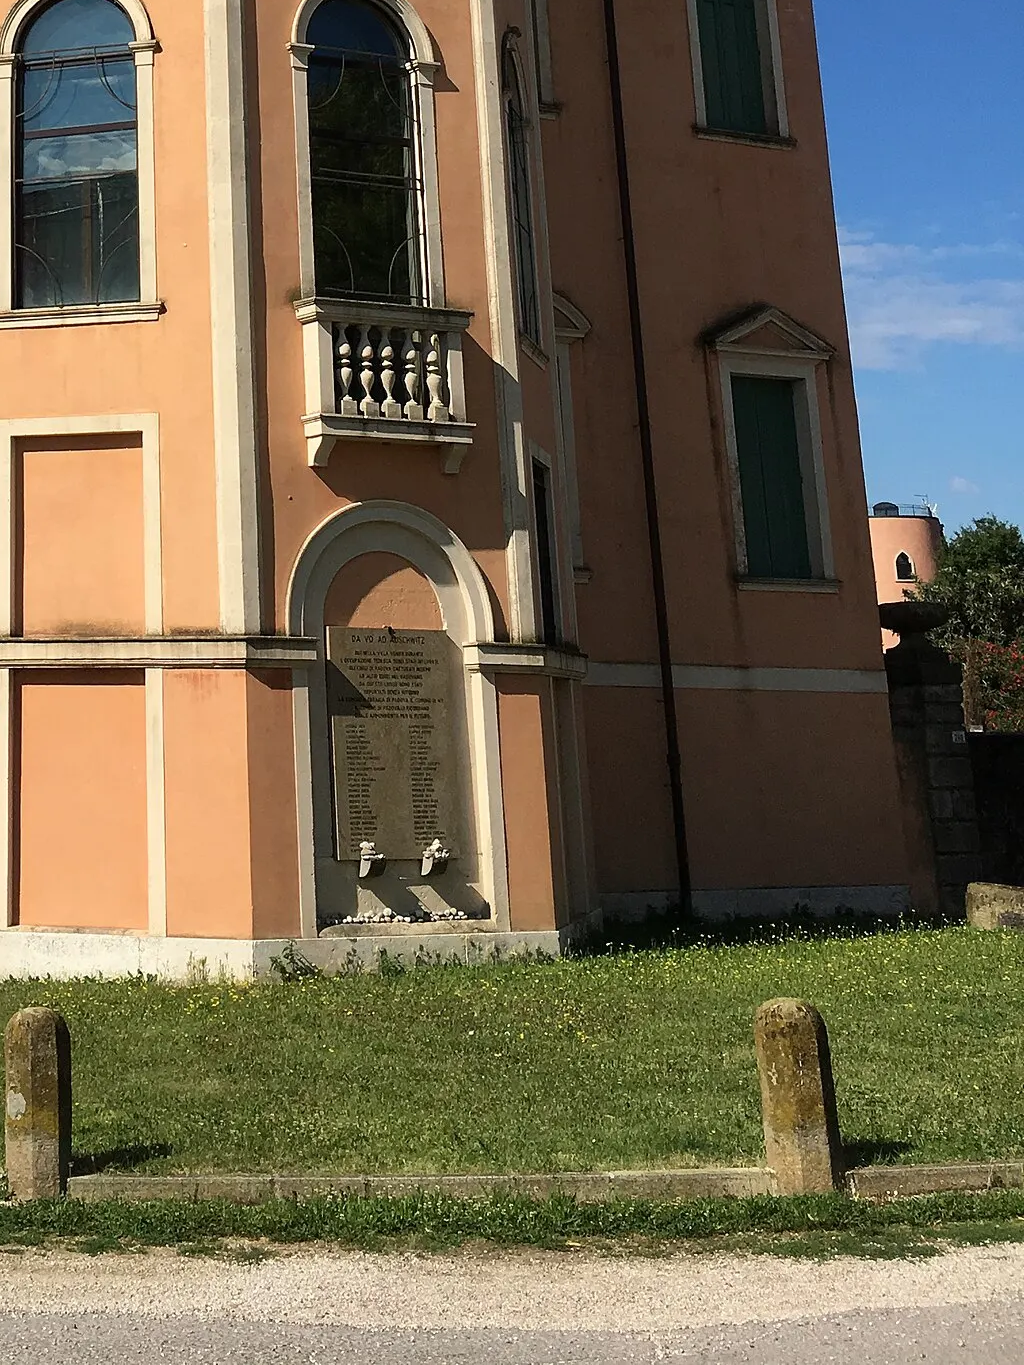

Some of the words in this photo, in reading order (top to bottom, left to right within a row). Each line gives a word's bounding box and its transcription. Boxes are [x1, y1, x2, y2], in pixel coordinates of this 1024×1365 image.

[352, 635, 361, 643] DA
[378, 636, 387, 644] AD
[390, 636, 425, 645] AUSCHWITZ
